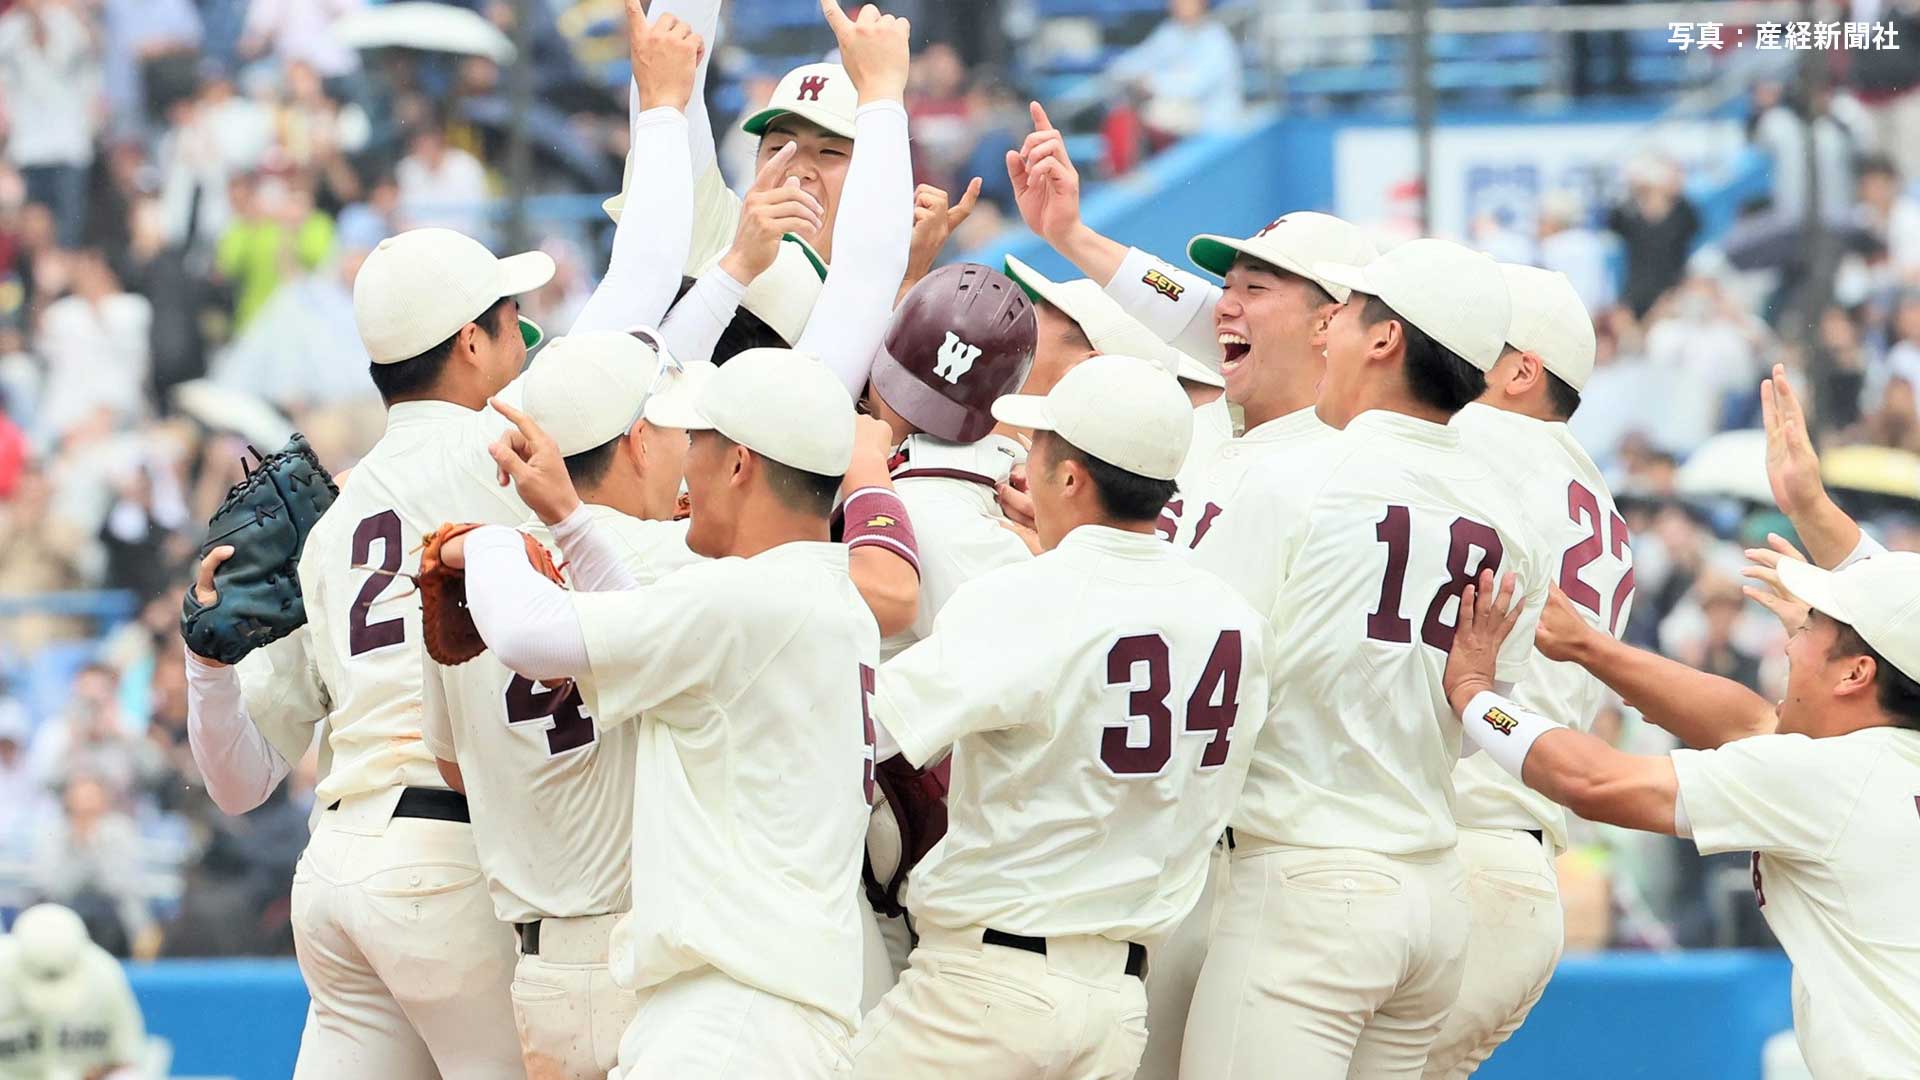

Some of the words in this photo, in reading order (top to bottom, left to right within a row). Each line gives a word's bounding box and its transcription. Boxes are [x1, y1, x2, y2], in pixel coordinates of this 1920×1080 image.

[797, 75, 829, 101] W
[1143, 269, 1184, 301] ZETT
[932, 331, 982, 384] W
[350, 509, 405, 656] 2
[1367, 505, 1503, 654] 18
[1100, 630, 1242, 773] 34
[1482, 707, 1519, 736] ZETT
